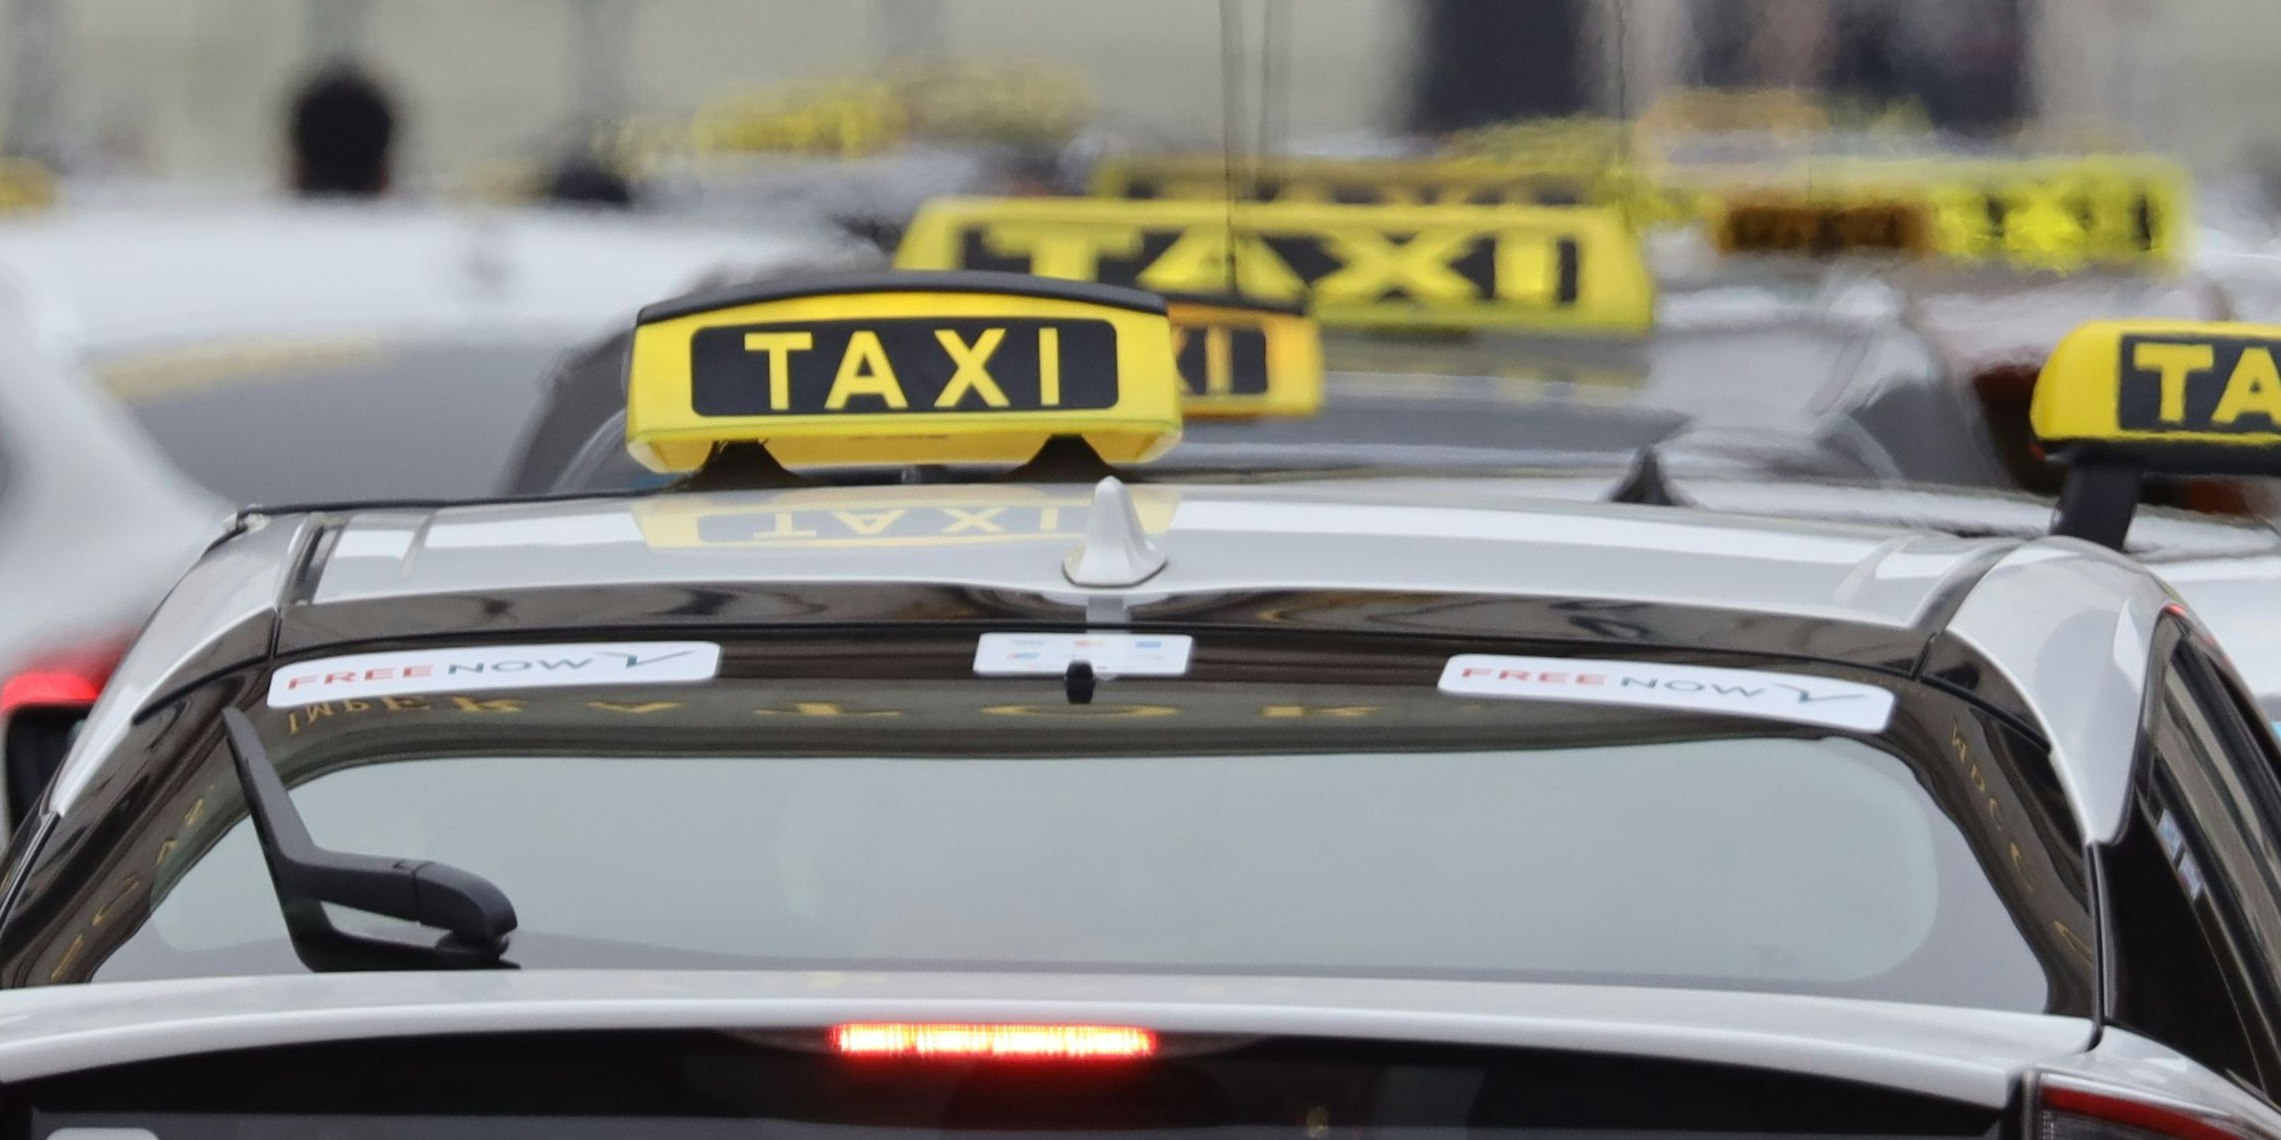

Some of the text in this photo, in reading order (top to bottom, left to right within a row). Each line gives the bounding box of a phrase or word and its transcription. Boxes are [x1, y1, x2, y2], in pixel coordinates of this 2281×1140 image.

[981, 228, 1556, 297] TAXI
[744, 327, 1061, 411] TAXI
[287, 657, 593, 690] FREE NOW
[1461, 667, 1765, 698] FREE NOW
